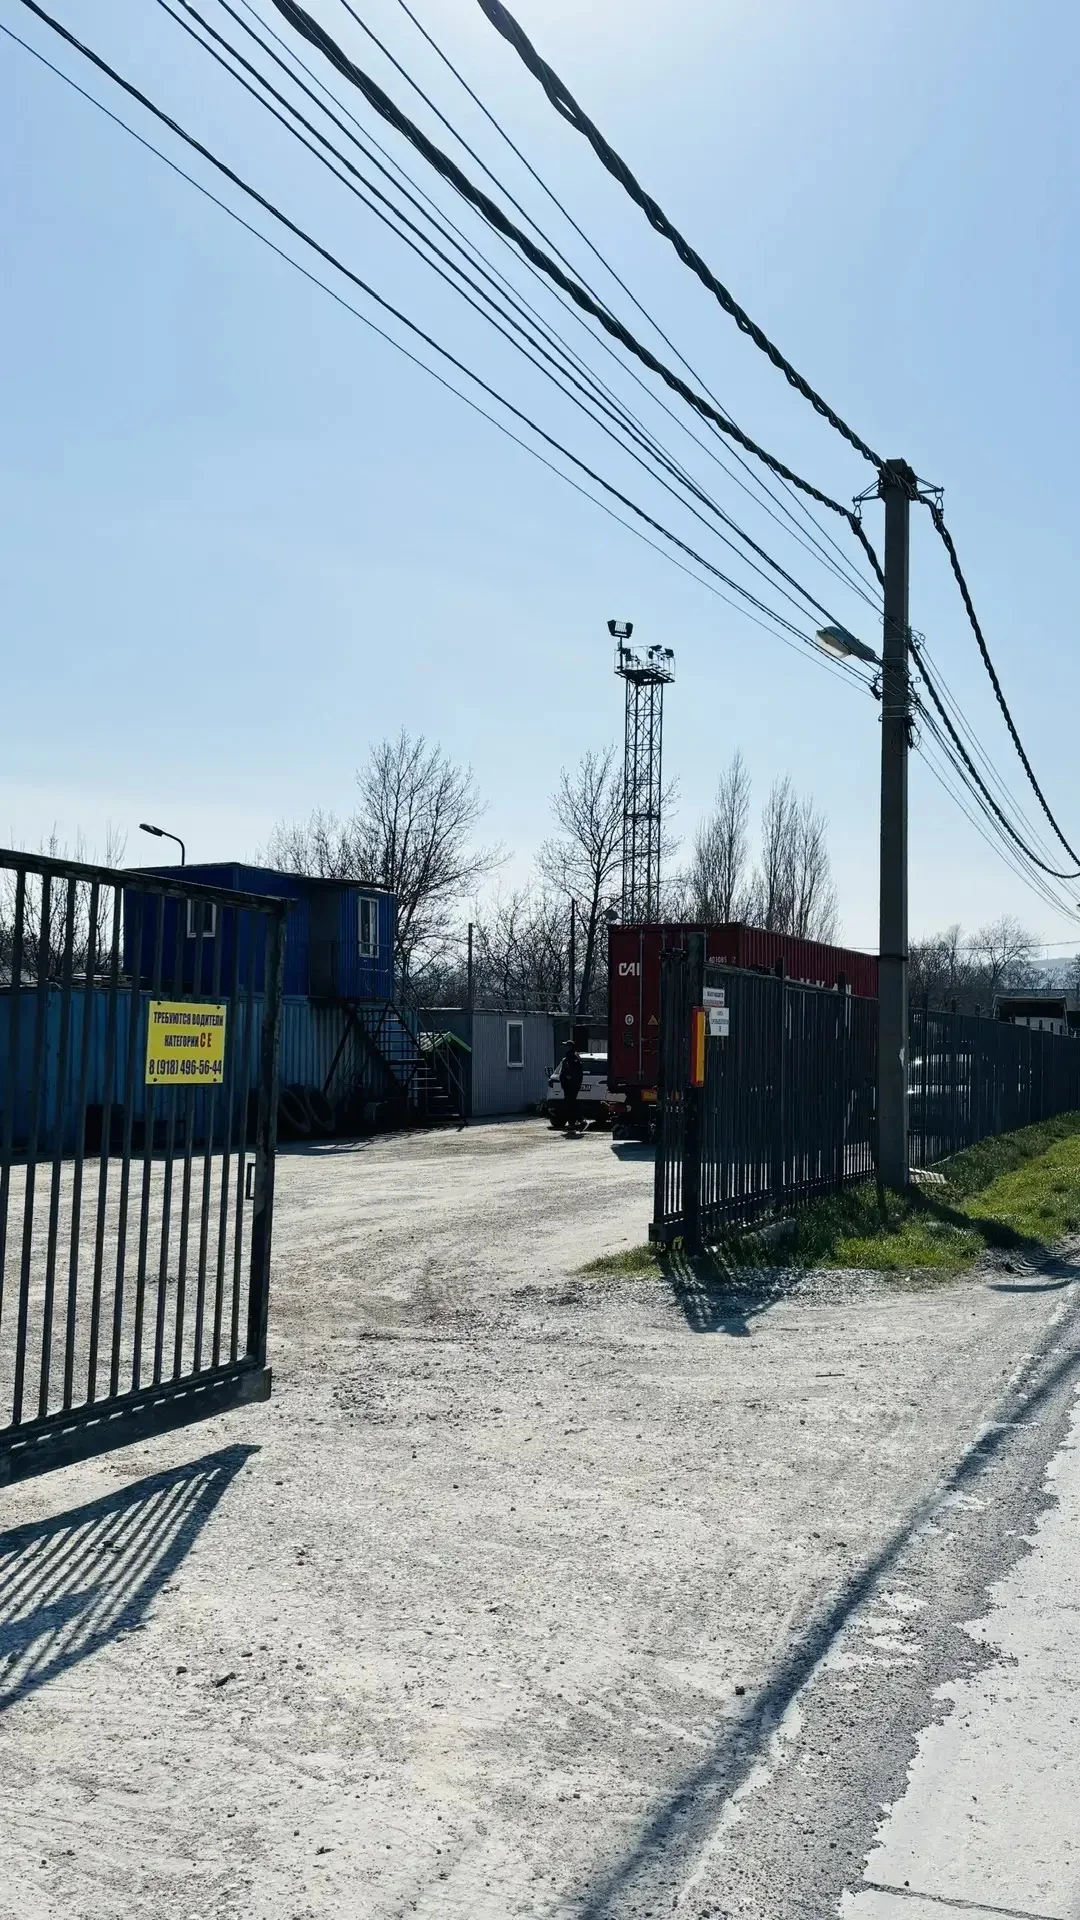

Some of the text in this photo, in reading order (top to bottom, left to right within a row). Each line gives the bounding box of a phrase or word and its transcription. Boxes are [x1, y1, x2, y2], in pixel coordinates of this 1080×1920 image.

[618, 962, 640, 976] CAI
[153, 1011, 224, 1027] ТРЕБУЮТСЯ ВОДИТЕЛИ
[164, 1034, 200, 1048] КАТЕГОРИИ
[148, 1059, 222, 1075] 8 (918) 496-56-44
